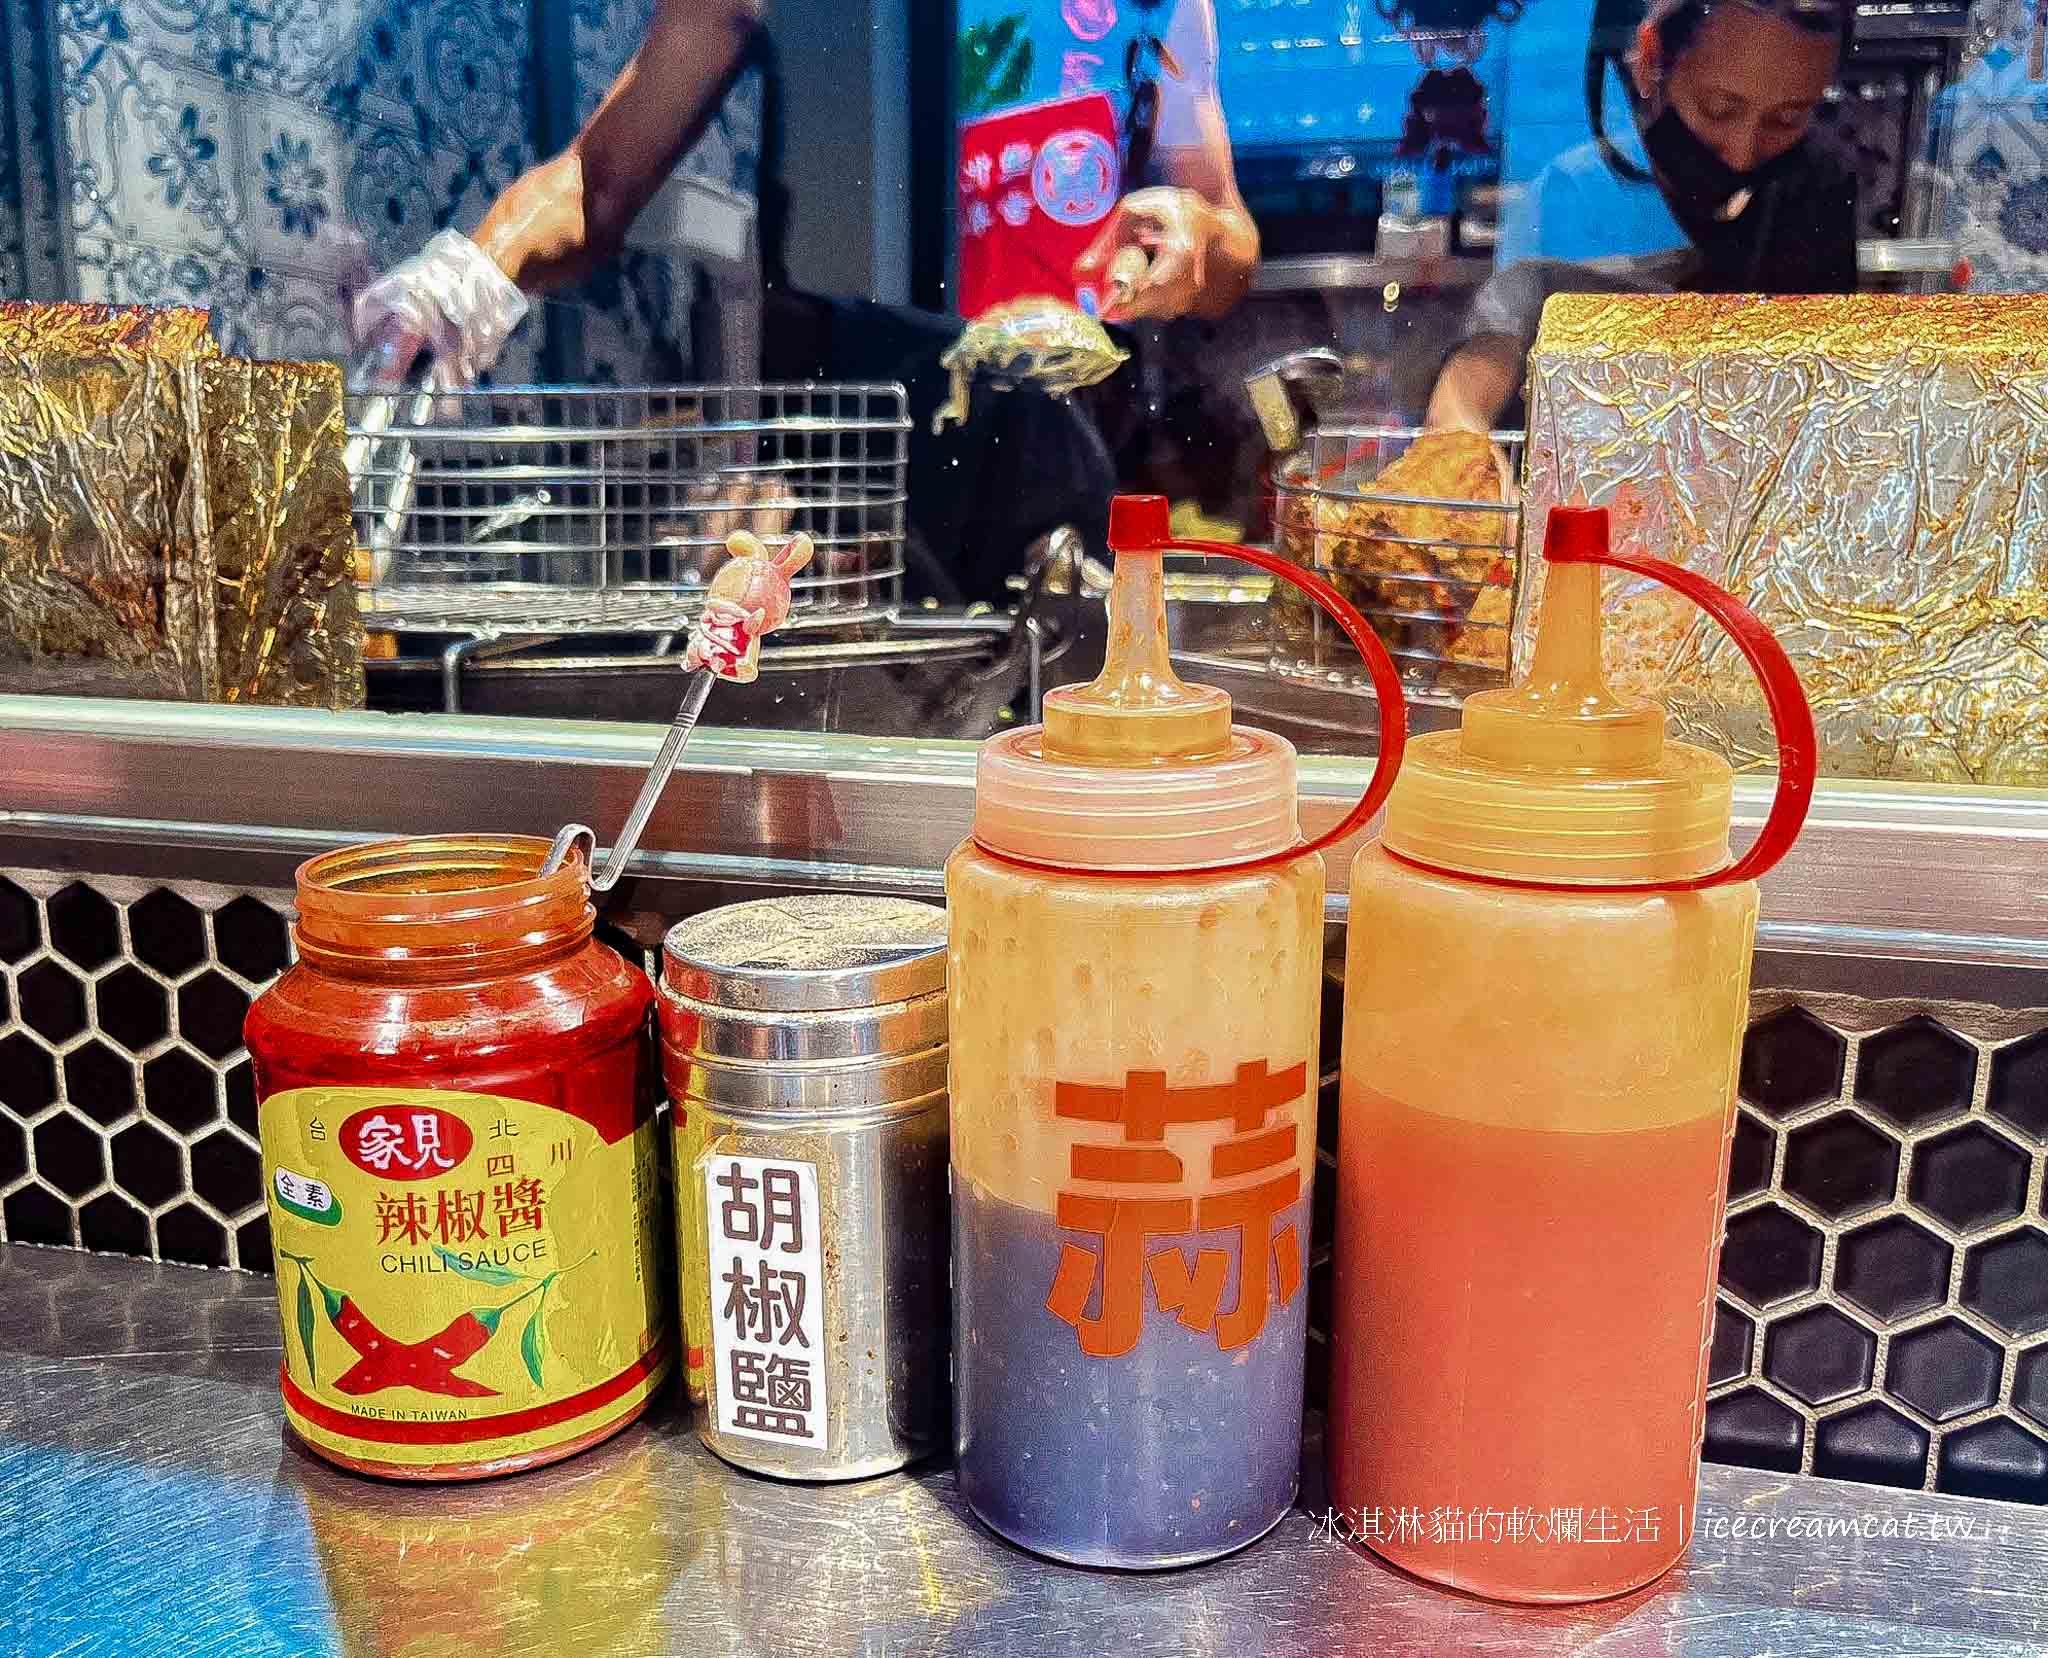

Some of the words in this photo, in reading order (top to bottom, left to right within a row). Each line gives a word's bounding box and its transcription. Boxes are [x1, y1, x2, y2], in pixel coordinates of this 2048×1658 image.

[309, 1116, 327, 1142] 台
[488, 1118, 521, 1141] 北
[487, 1153, 516, 1179] 四
[550, 1140, 574, 1165] 川
[279, 1173, 325, 1210] 全素
[1046, 1057, 1307, 1358] 蒜
[375, 1177, 547, 1247] 辣椒醬
[380, 1252, 449, 1274] CHILI
[458, 1239, 548, 1272] SAUCE
[716, 1162, 814, 1439] 胡椒鹽
[351, 1404, 386, 1420] MADE
[391, 1409, 406, 1420] IN
[409, 1408, 469, 1421] TAIWAN
